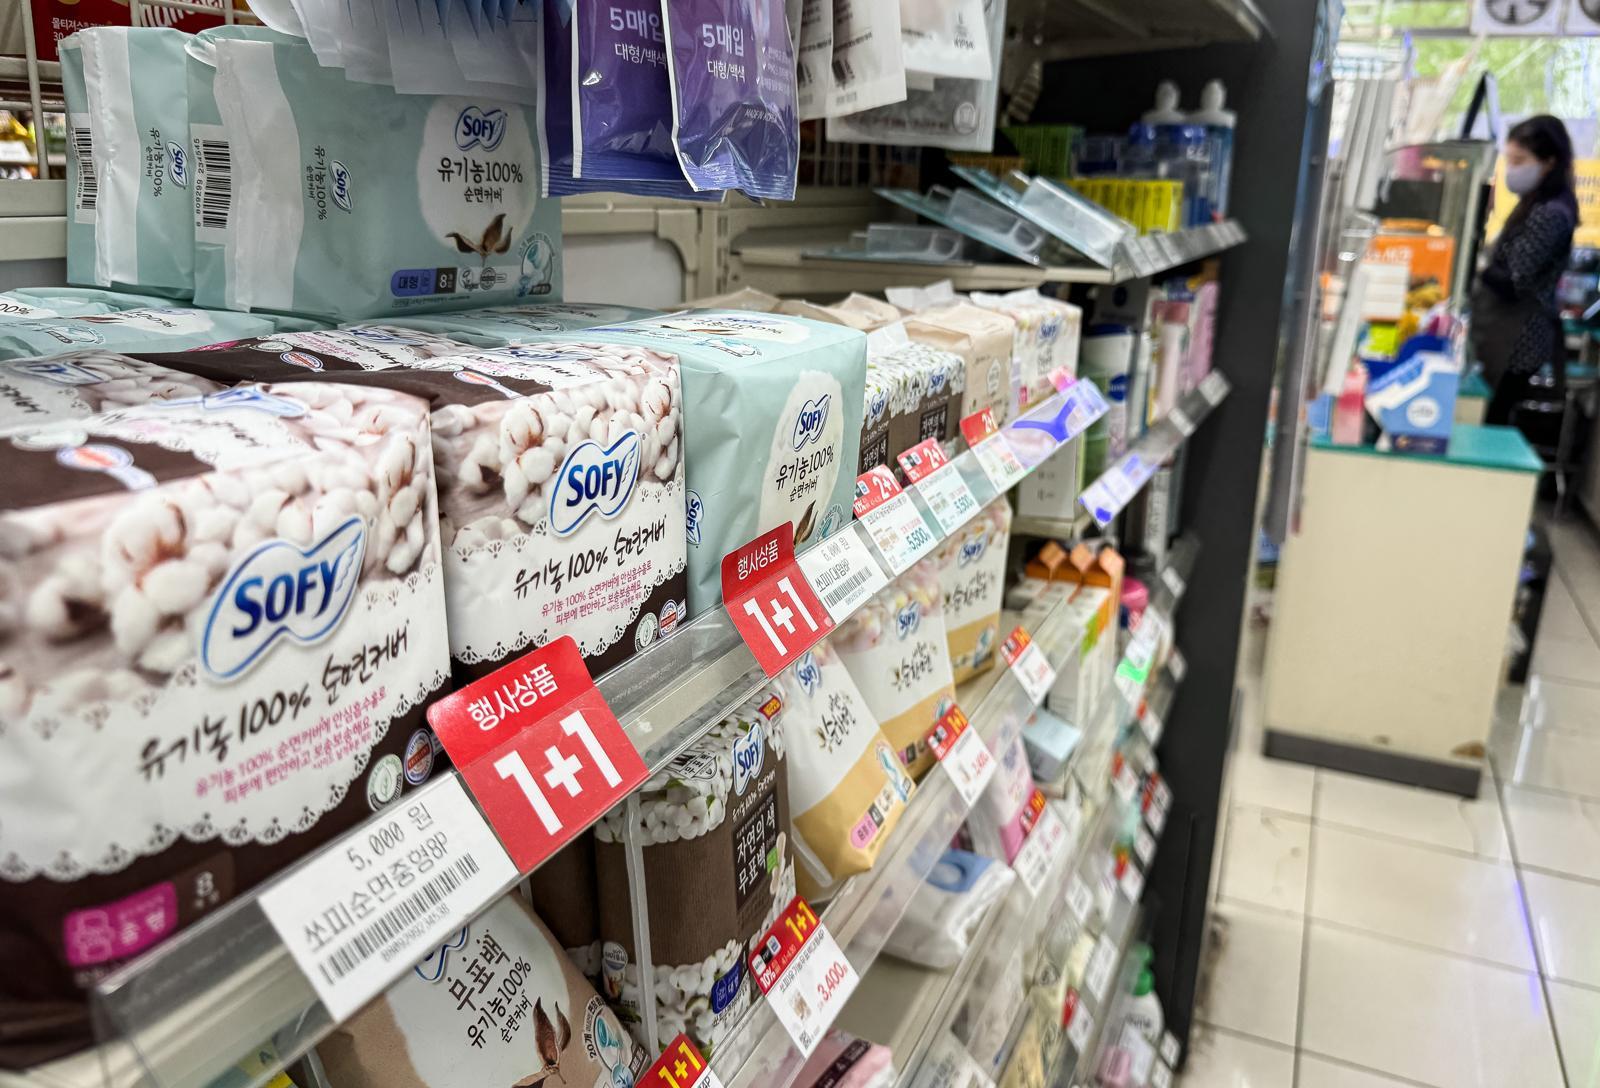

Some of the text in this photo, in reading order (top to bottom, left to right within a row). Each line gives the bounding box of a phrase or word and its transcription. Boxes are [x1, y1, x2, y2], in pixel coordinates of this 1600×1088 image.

[703, 24, 744, 57] 5매입
[707, 60, 745, 82] 대형/백색
[463, 115, 495, 142] SOFY
[150, 127, 164, 197] 유기농100%
[172, 148, 184, 182] SOFY
[314, 145, 328, 220] 유기농100%
[437, 157, 523, 183] 유기농100%
[335, 168, 348, 202] SOFY
[464, 187, 503, 204] 순면커버
[440, 274, 447, 288] 8
[799, 406, 824, 436] SOFY
[566, 459, 625, 508] SOFY
[776, 444, 835, 490] 유기농100%
[872, 474, 900, 501] 2+1
[514, 558, 564, 600] 유기농
[568, 546, 608, 581] 100%
[737, 538, 779, 580] 행사상품
[232, 558, 341, 639] SOFY
[542, 600, 564, 619] 유기농
[565, 591, 586, 610] 100%
[556, 580, 643, 625] 피부에 편안하고 보송보송해요
[743, 576, 819, 657] 1+1
[466, 663, 558, 731] 행사상품
[139, 714, 233, 782] 유기농
[239, 684, 311, 742] 100%
[493, 710, 623, 836] 1+1
[737, 741, 760, 777] SOFY
[347, 802, 434, 872] 5,000 원
[737, 813, 765, 864] 자연의
[303, 831, 449, 953] 쏘피순면중형8P
[785, 900, 817, 942] 1+1
[448, 930, 511, 1012] 무표백
[817, 961, 845, 1001] 3,400
[467, 956, 532, 1049] 유기농100%
[500, 995, 533, 1043] 순면커버
[584, 1032, 597, 1058] 20개
[658, 1041, 702, 1088] 1+1
